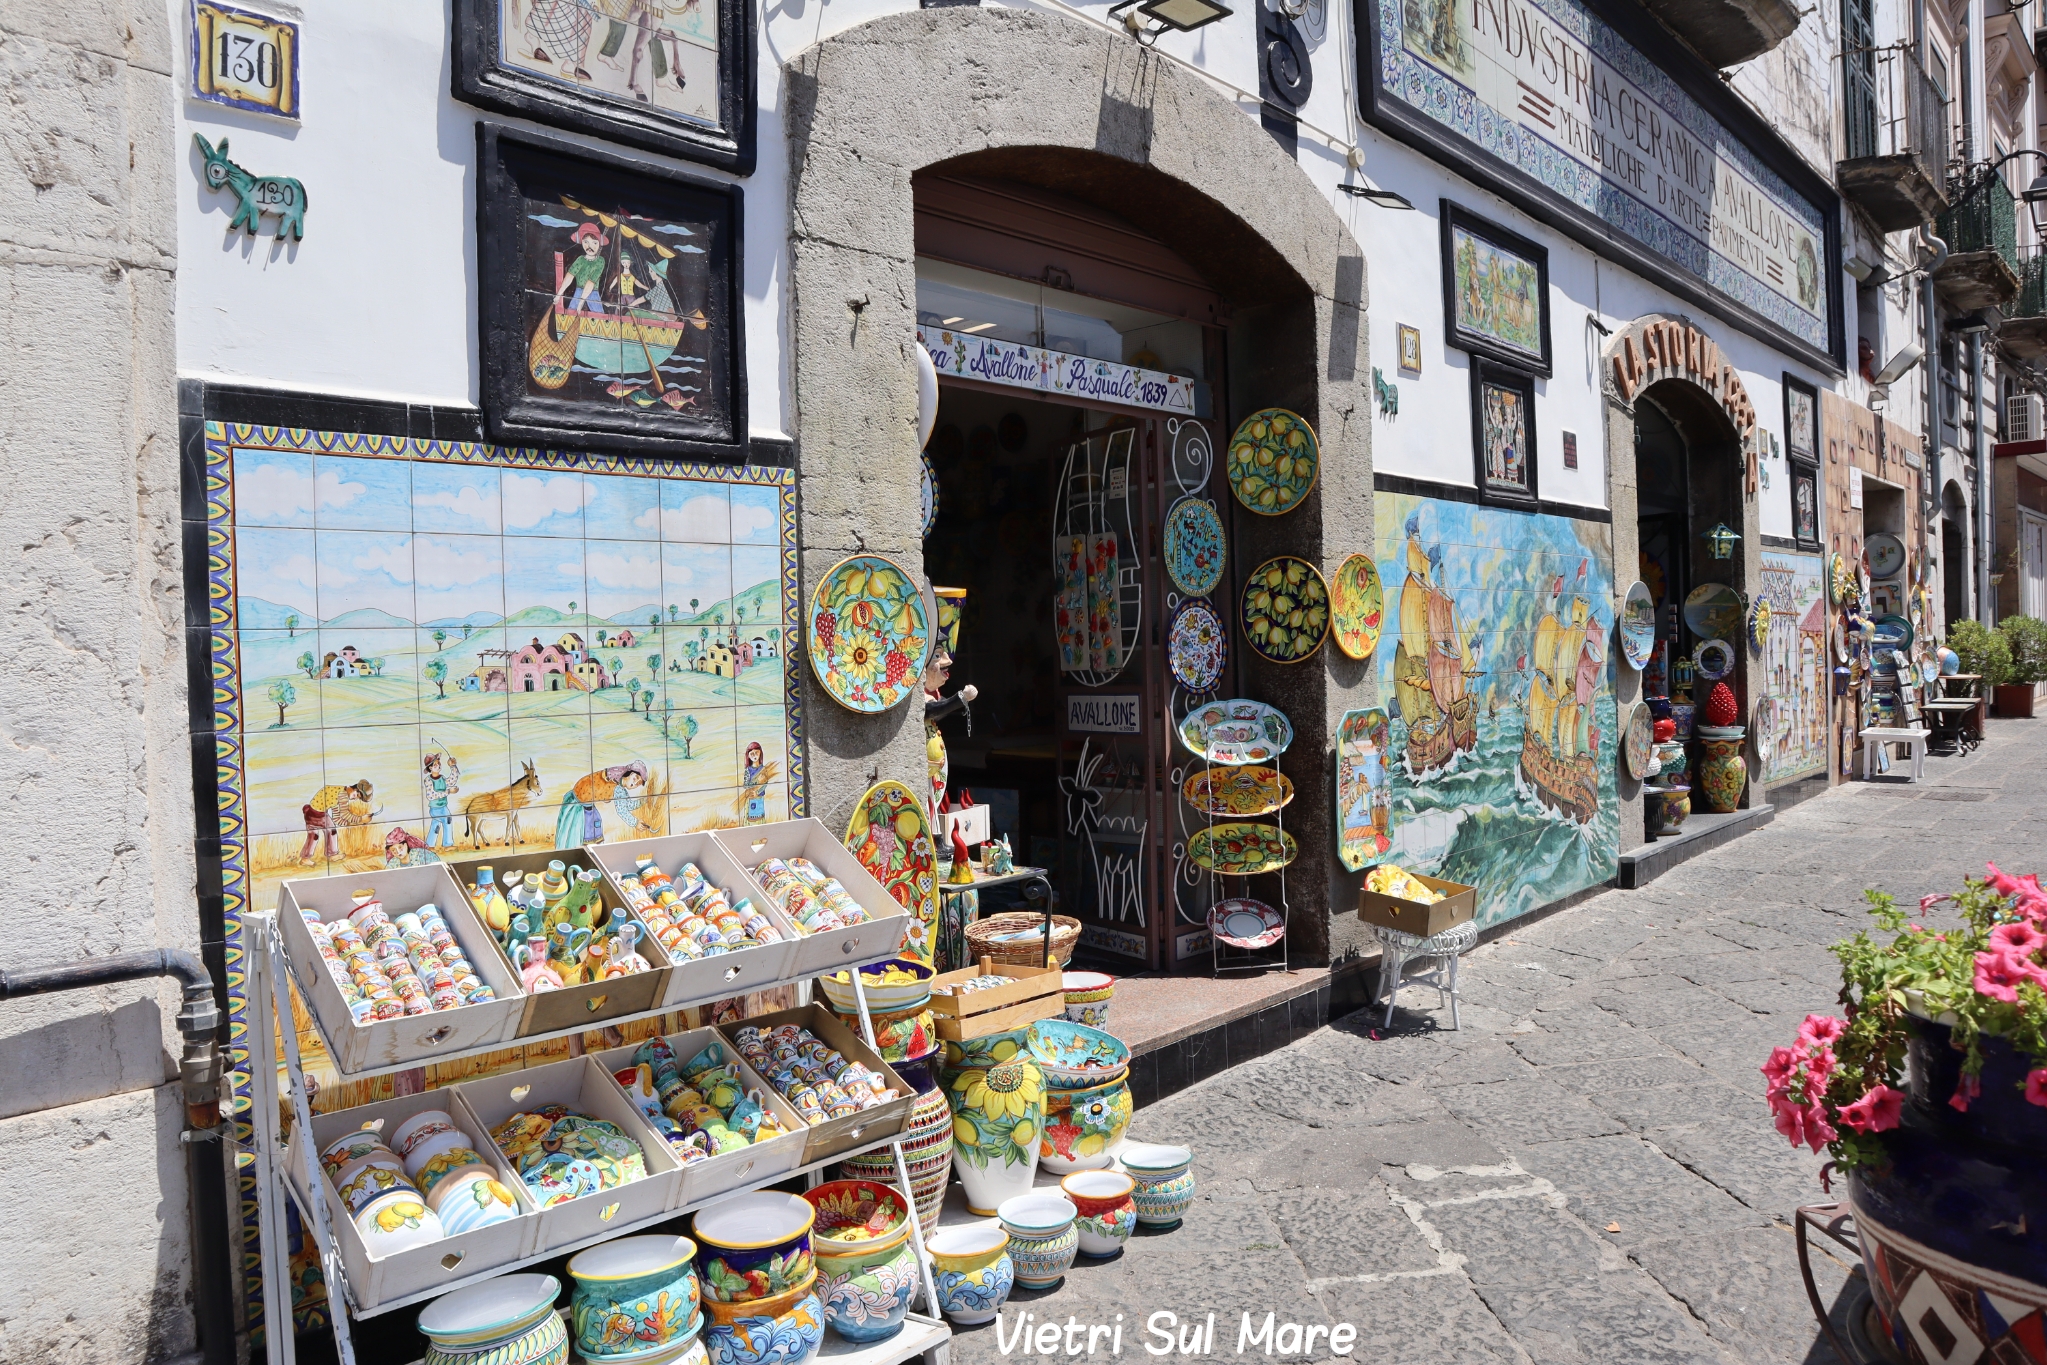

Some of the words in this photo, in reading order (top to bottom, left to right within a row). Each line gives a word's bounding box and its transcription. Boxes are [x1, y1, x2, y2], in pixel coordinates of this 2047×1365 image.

[216, 31, 279, 89] 130
[256, 181, 295, 207] 130
[1559, 106, 1648, 194] MAIOLICHE
[1657, 174, 1703, 232] D'ARTE
[1711, 213, 1765, 275] PAVIMENTI
[1618, 88, 1719, 206] CERAMICA
[1723, 173, 1797, 264] AVALLONE
[969, 340, 1039, 382] Avallone
[1066, 358, 1136, 400] Pasquale
[1140, 381, 1168, 407] 1839
[1403, 336, 1417, 360] 128
[1613, 335, 1645, 400] LA
[1644, 319, 1720, 389] STORIA
[1070, 702, 1137, 727] AVALLONE
